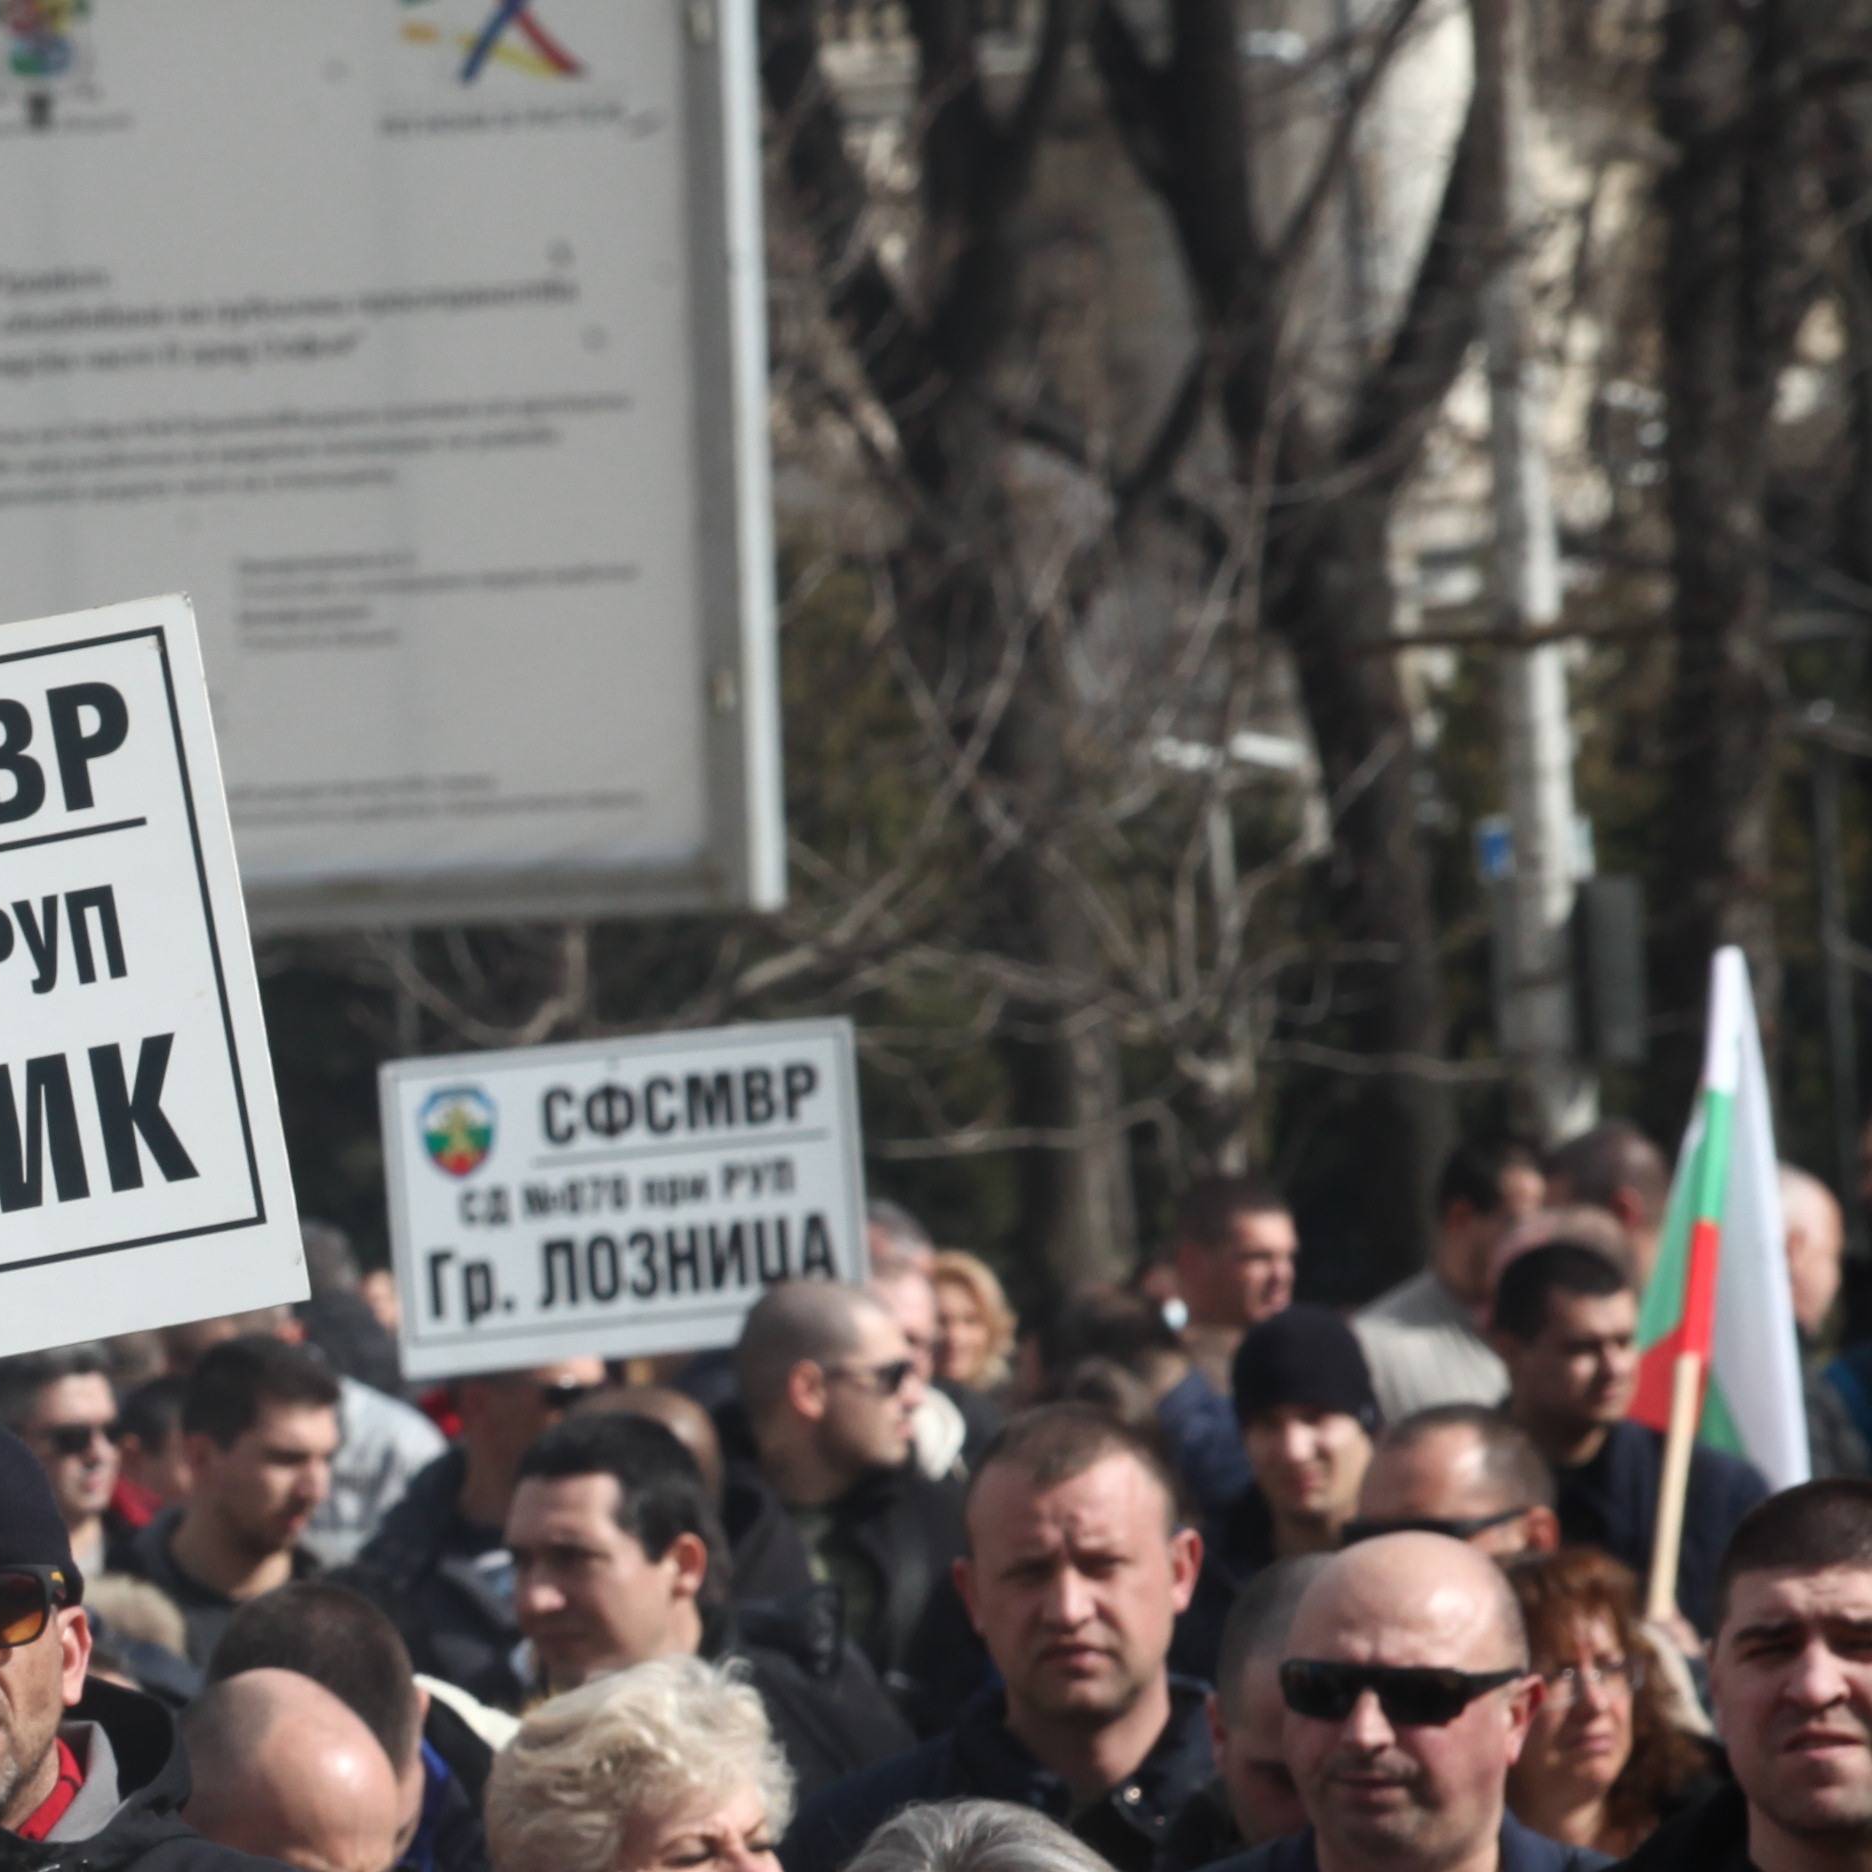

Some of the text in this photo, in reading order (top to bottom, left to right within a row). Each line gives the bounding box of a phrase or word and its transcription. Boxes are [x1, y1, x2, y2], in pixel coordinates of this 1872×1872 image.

[540, 1062, 818, 1146] СФСМВР
[459, 1186, 510, 1226] СД
[642, 1174, 709, 1208] при
[722, 1157, 795, 1196] РУП
[427, 1213, 838, 1325] Гр. ЛОЗНИЦА
